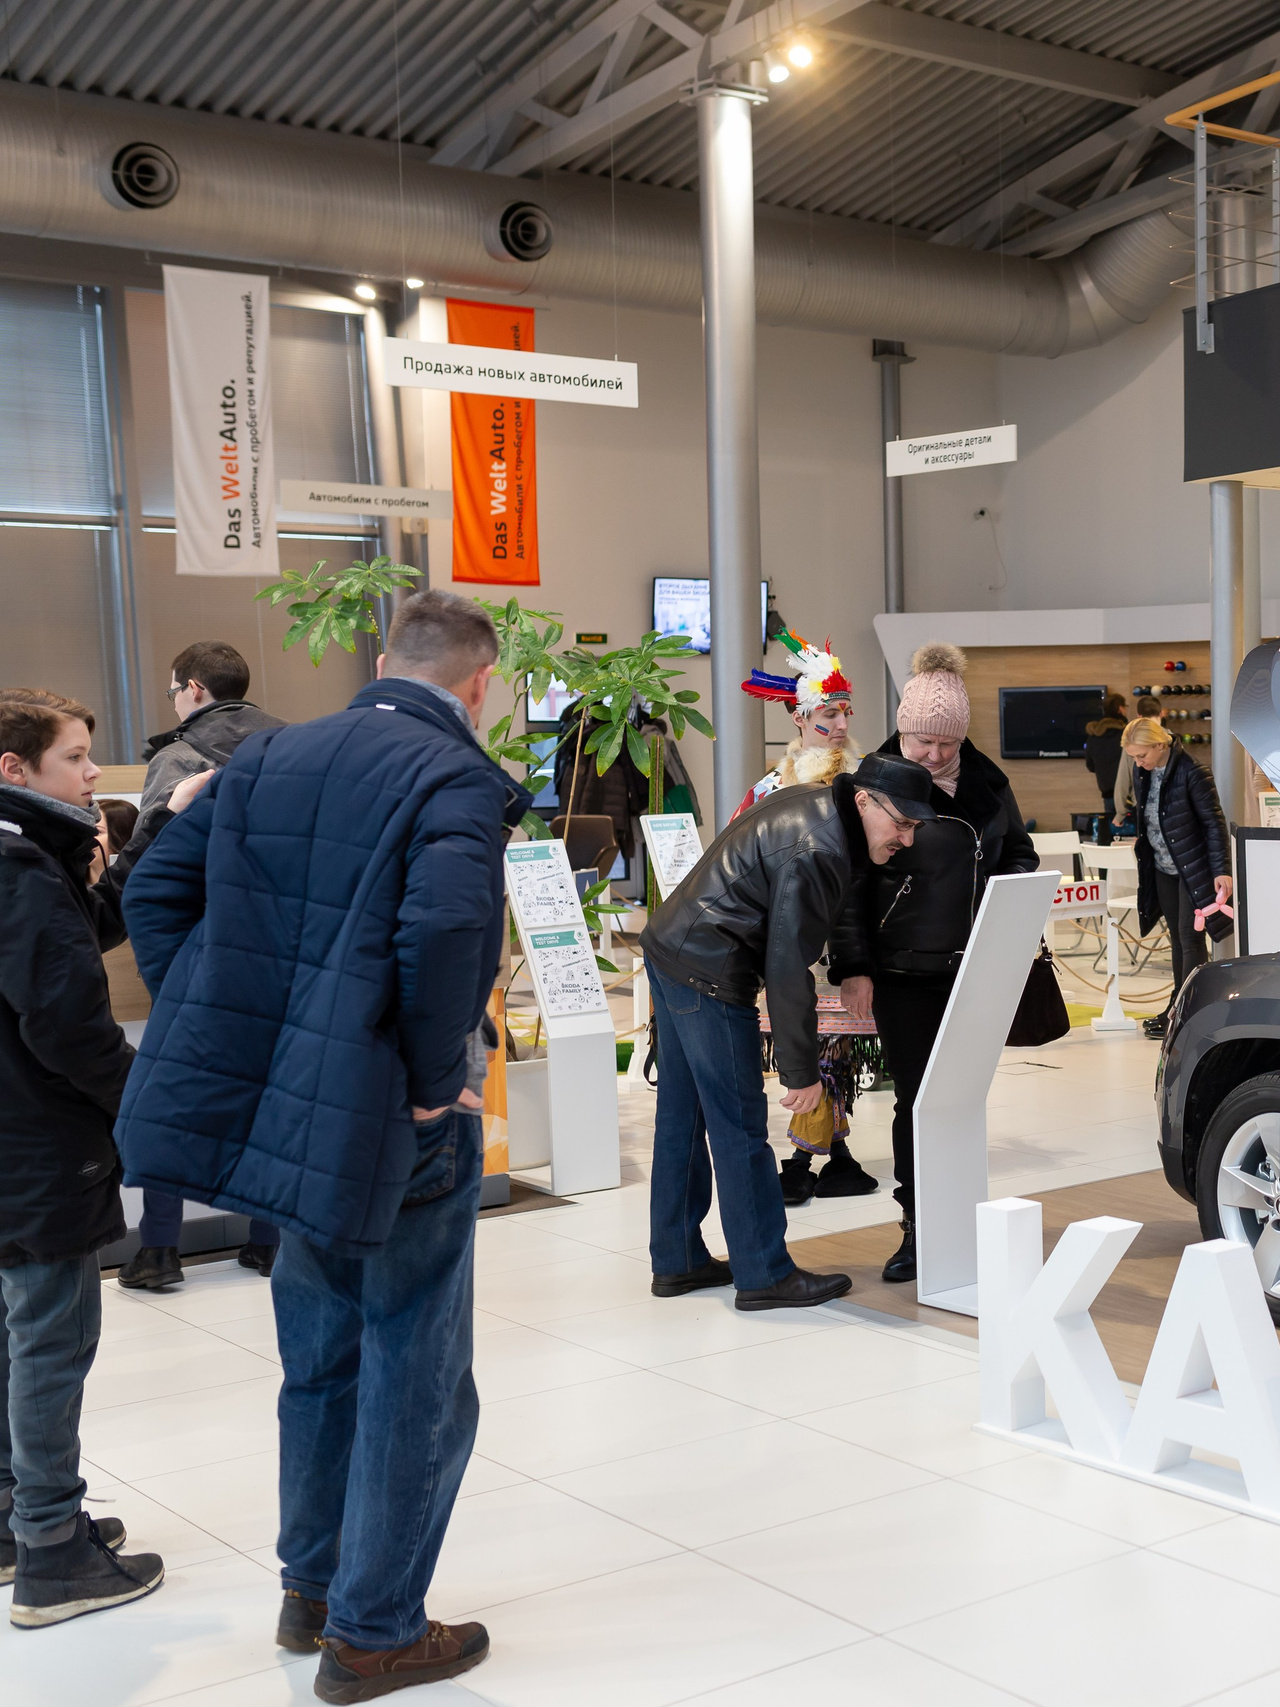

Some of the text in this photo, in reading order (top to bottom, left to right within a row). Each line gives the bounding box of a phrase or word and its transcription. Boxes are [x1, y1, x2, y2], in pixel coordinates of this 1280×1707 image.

[241, 291, 256, 373] репутацией.
[247, 377, 254, 385] и
[403, 356, 623, 391] Продажа новых автомобилей
[246, 389, 260, 452] пробегом
[513, 411, 523, 471] пробегом
[907, 434, 992, 455] Оригинальные детали
[924, 450, 975, 465] и аксессуары
[250, 466, 261, 549] Автомобили
[309, 491, 372, 505] Автомобили
[381, 496, 430, 508] пробегом
[223, 508, 242, 549] Das
[493, 522, 507, 560] Das
[515, 484, 525, 559] Автомобили
